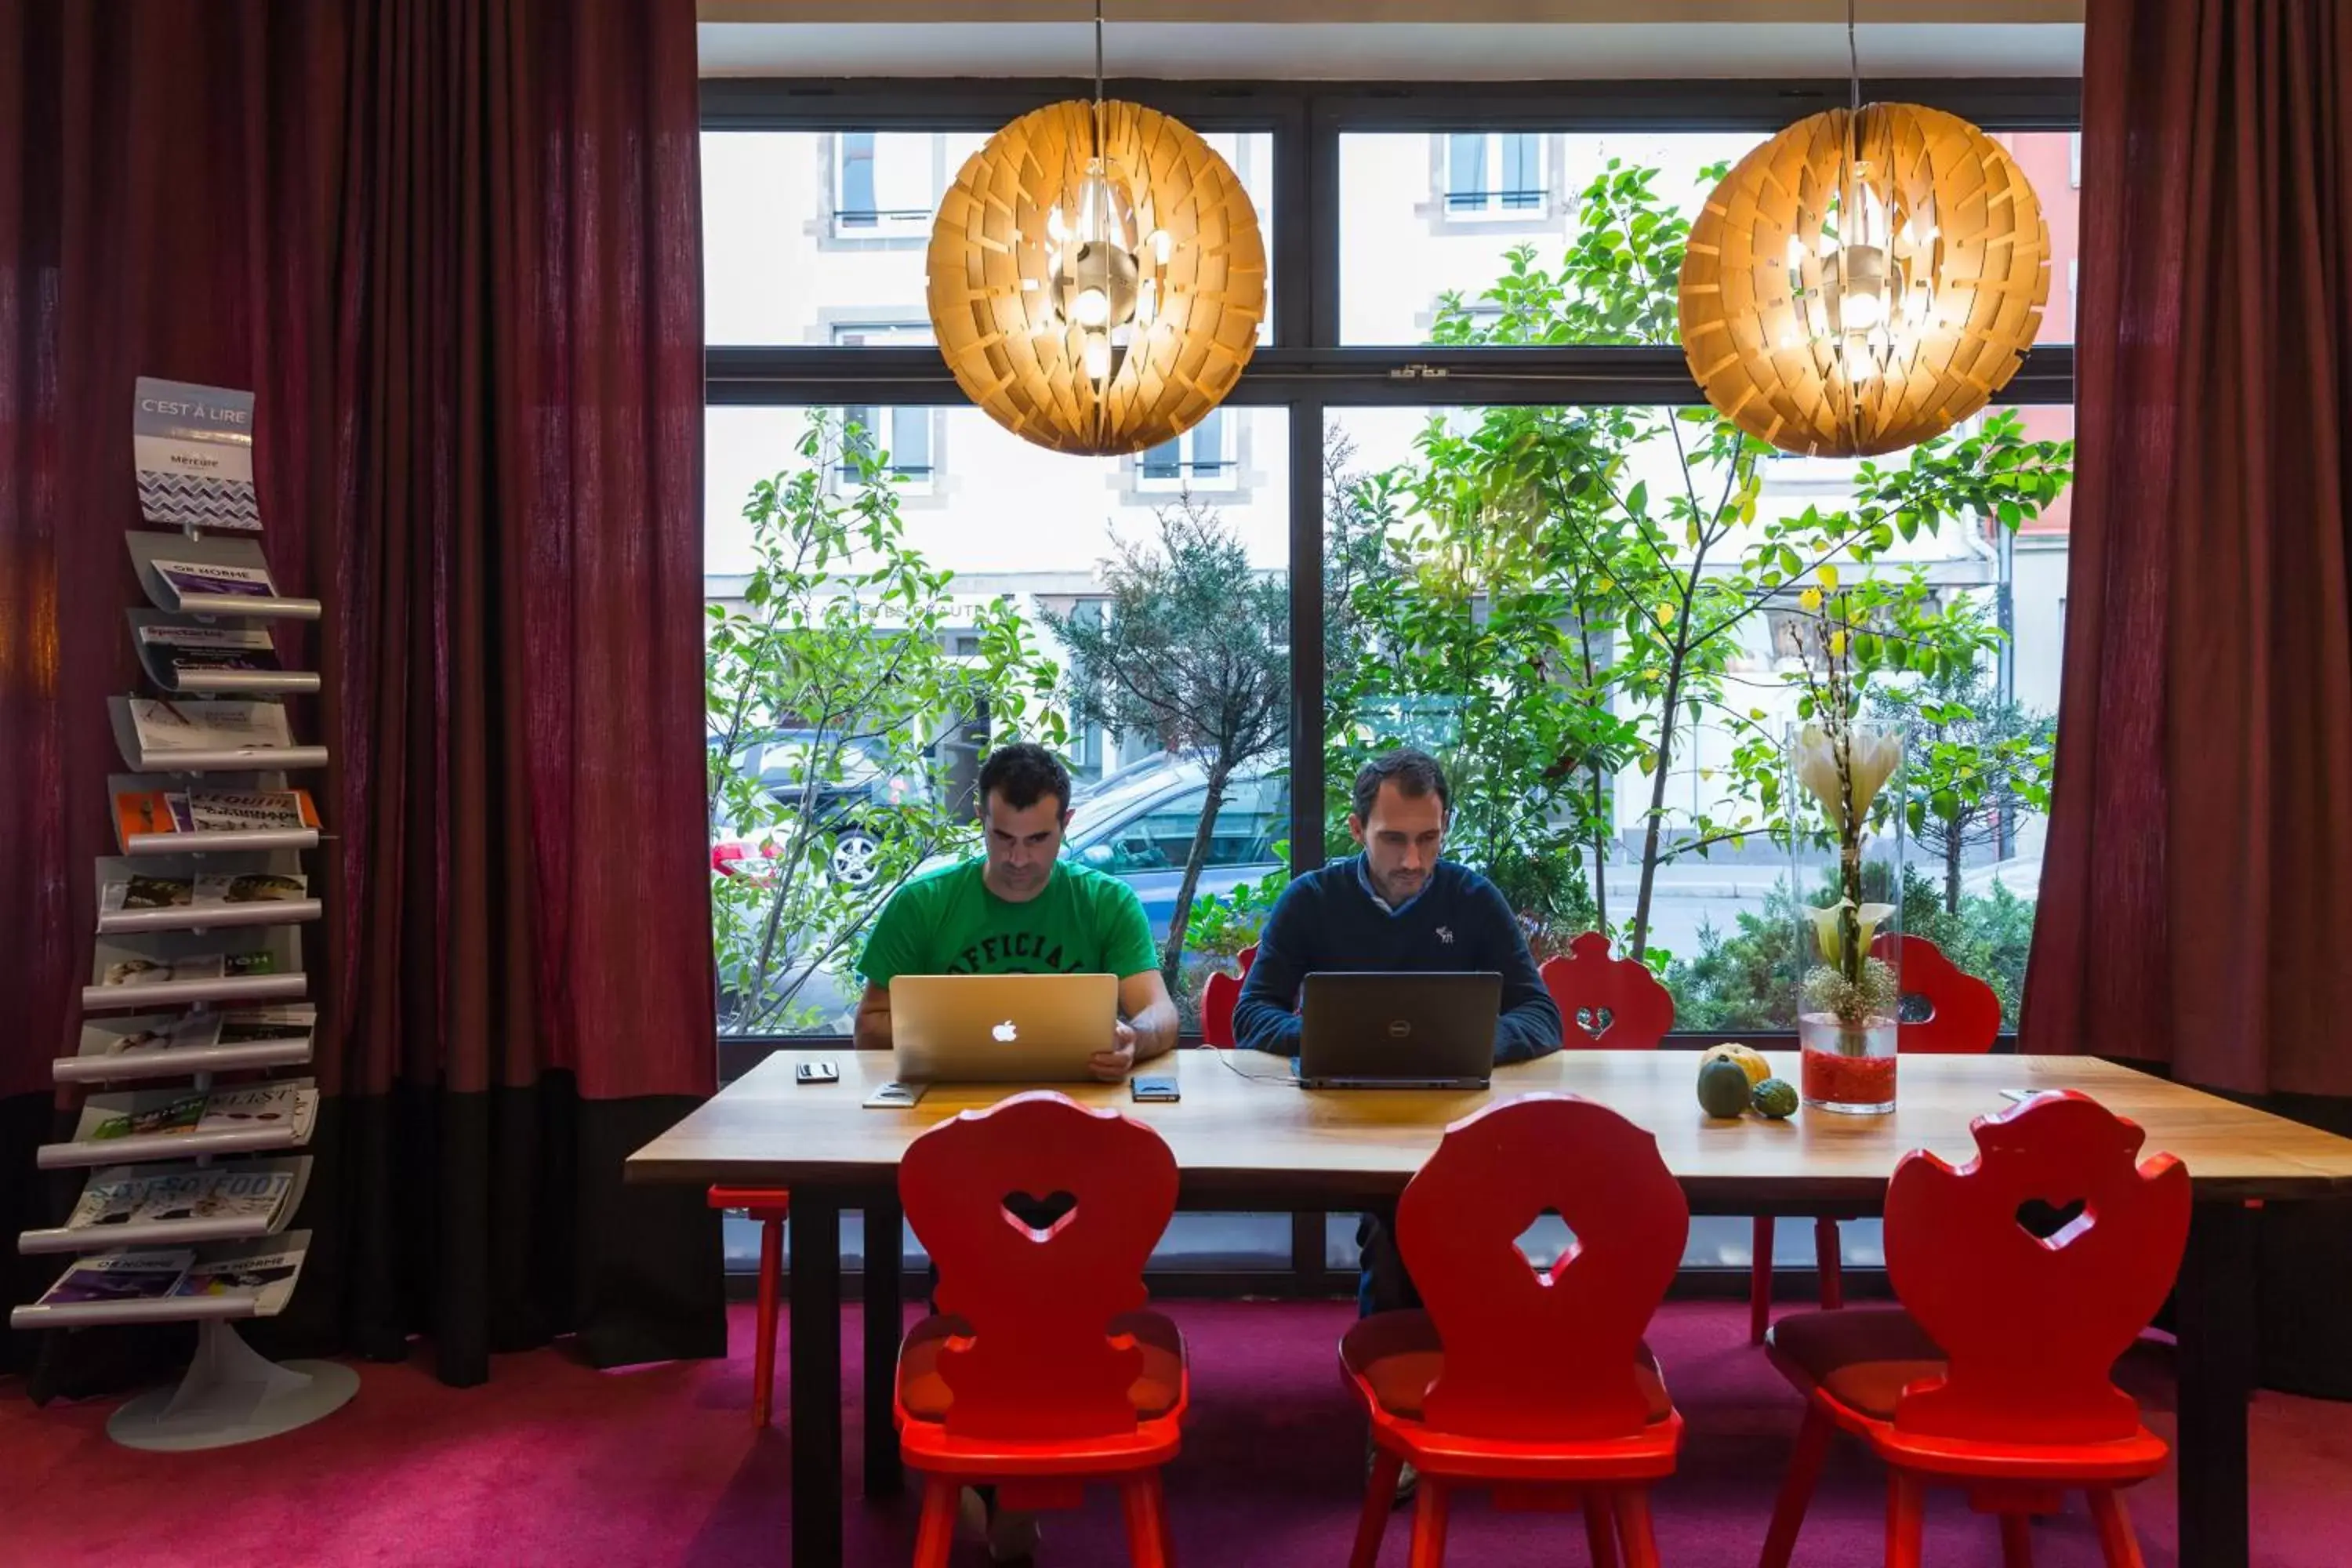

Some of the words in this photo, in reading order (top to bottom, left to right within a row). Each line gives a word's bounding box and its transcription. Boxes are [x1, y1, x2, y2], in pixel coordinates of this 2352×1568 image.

[142, 399, 189, 416] C'EST
[210, 408, 248, 424] LIRE
[170, 455, 219, 467] Mercure
